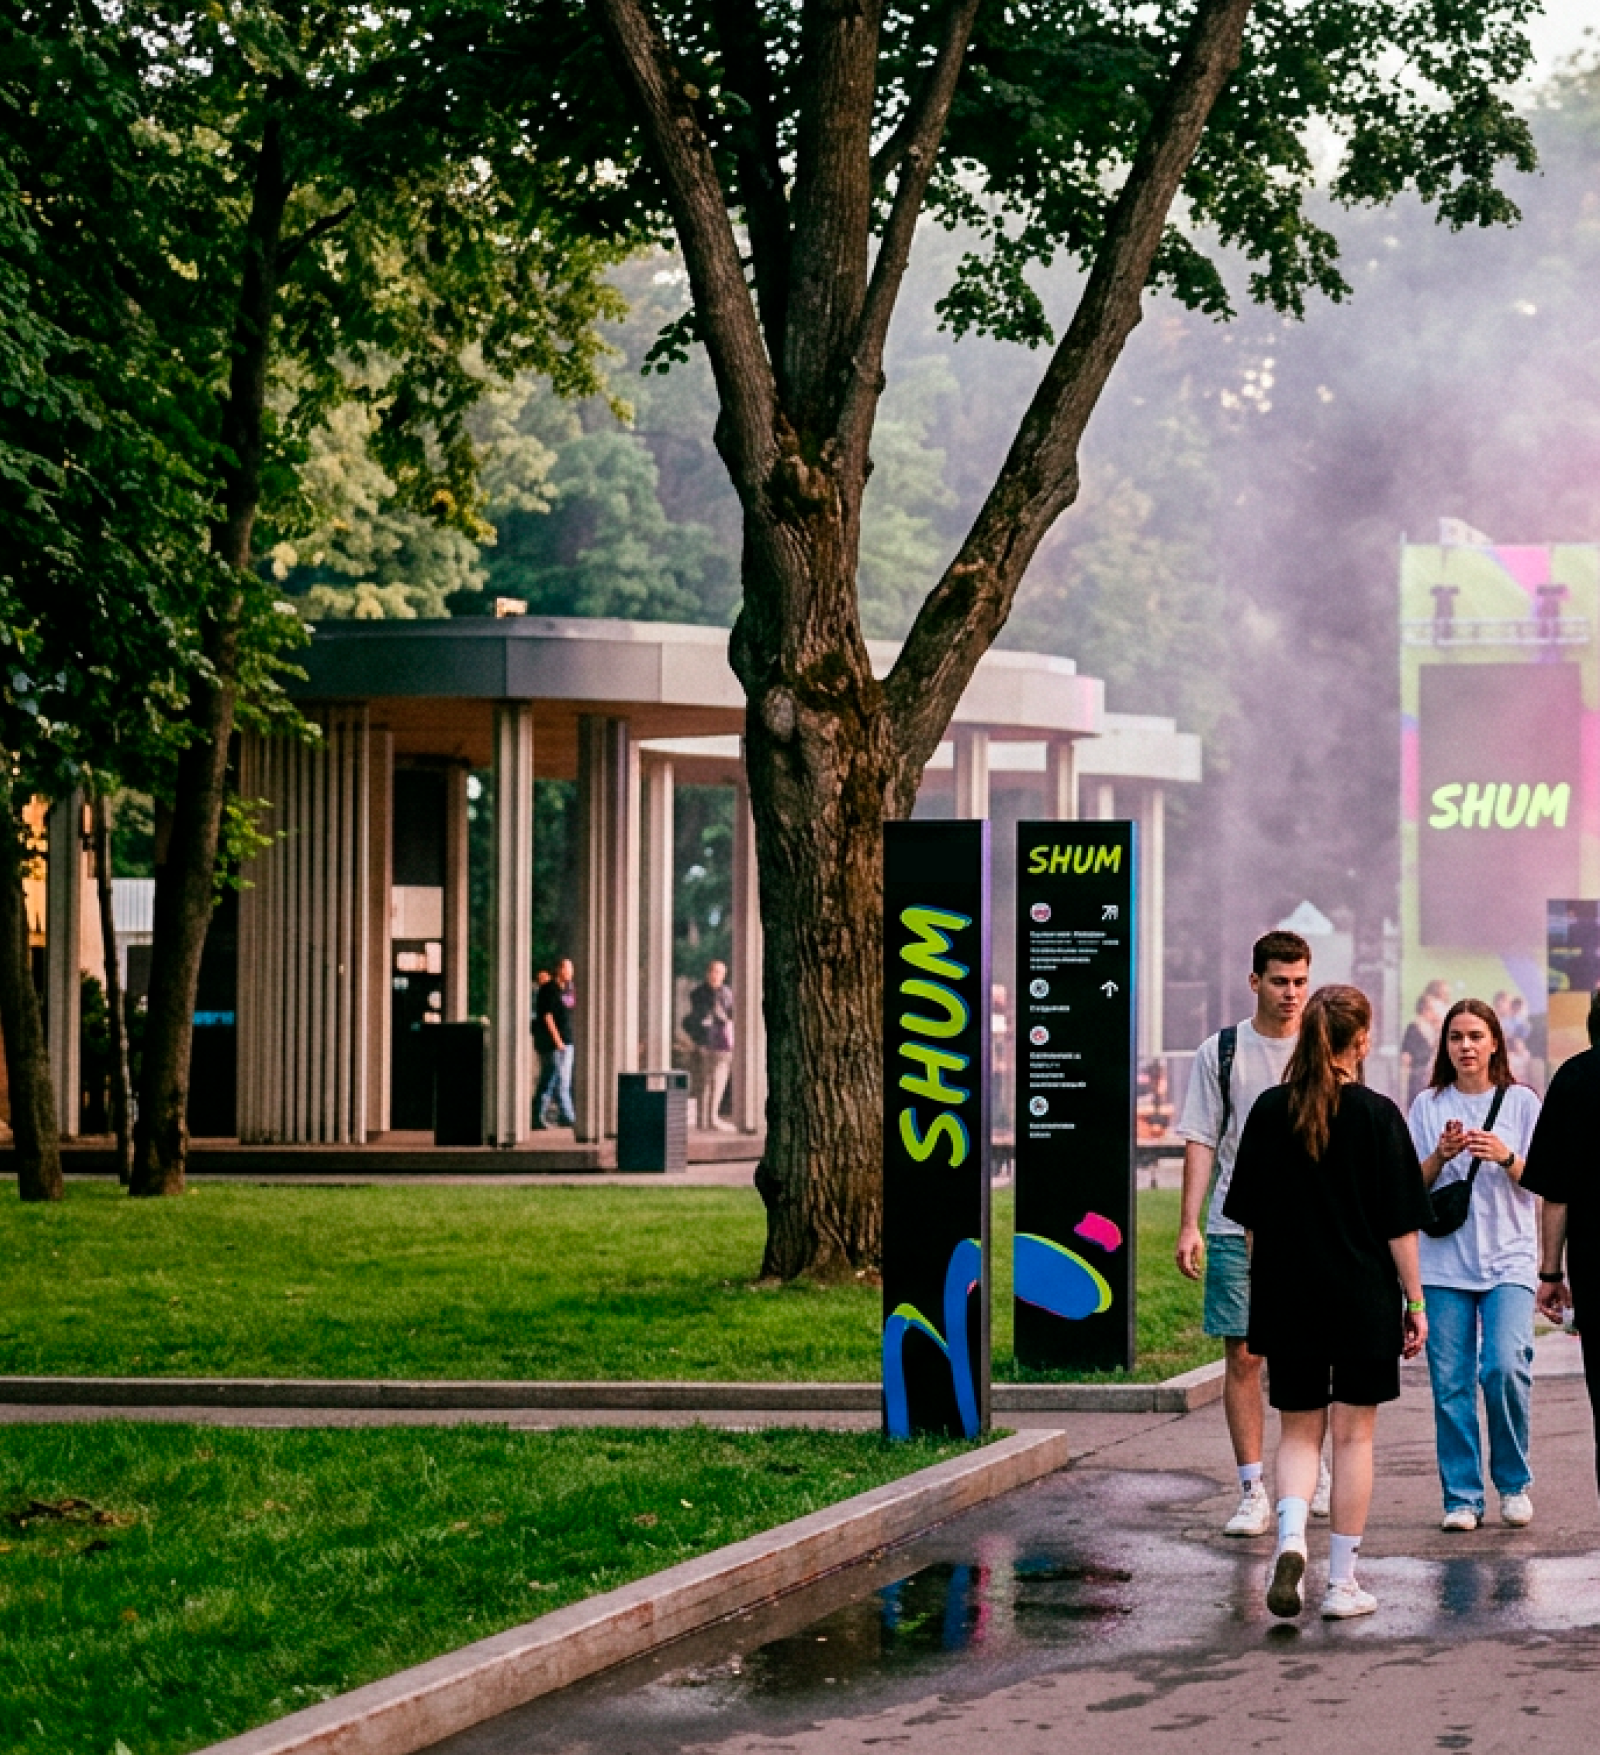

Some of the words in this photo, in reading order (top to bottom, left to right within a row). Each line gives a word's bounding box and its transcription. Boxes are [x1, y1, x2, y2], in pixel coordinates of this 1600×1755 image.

[1428, 782, 1570, 830] SHUM
[1027, 844, 1122, 874] SHUM
[899, 904, 971, 1169] SHUM
